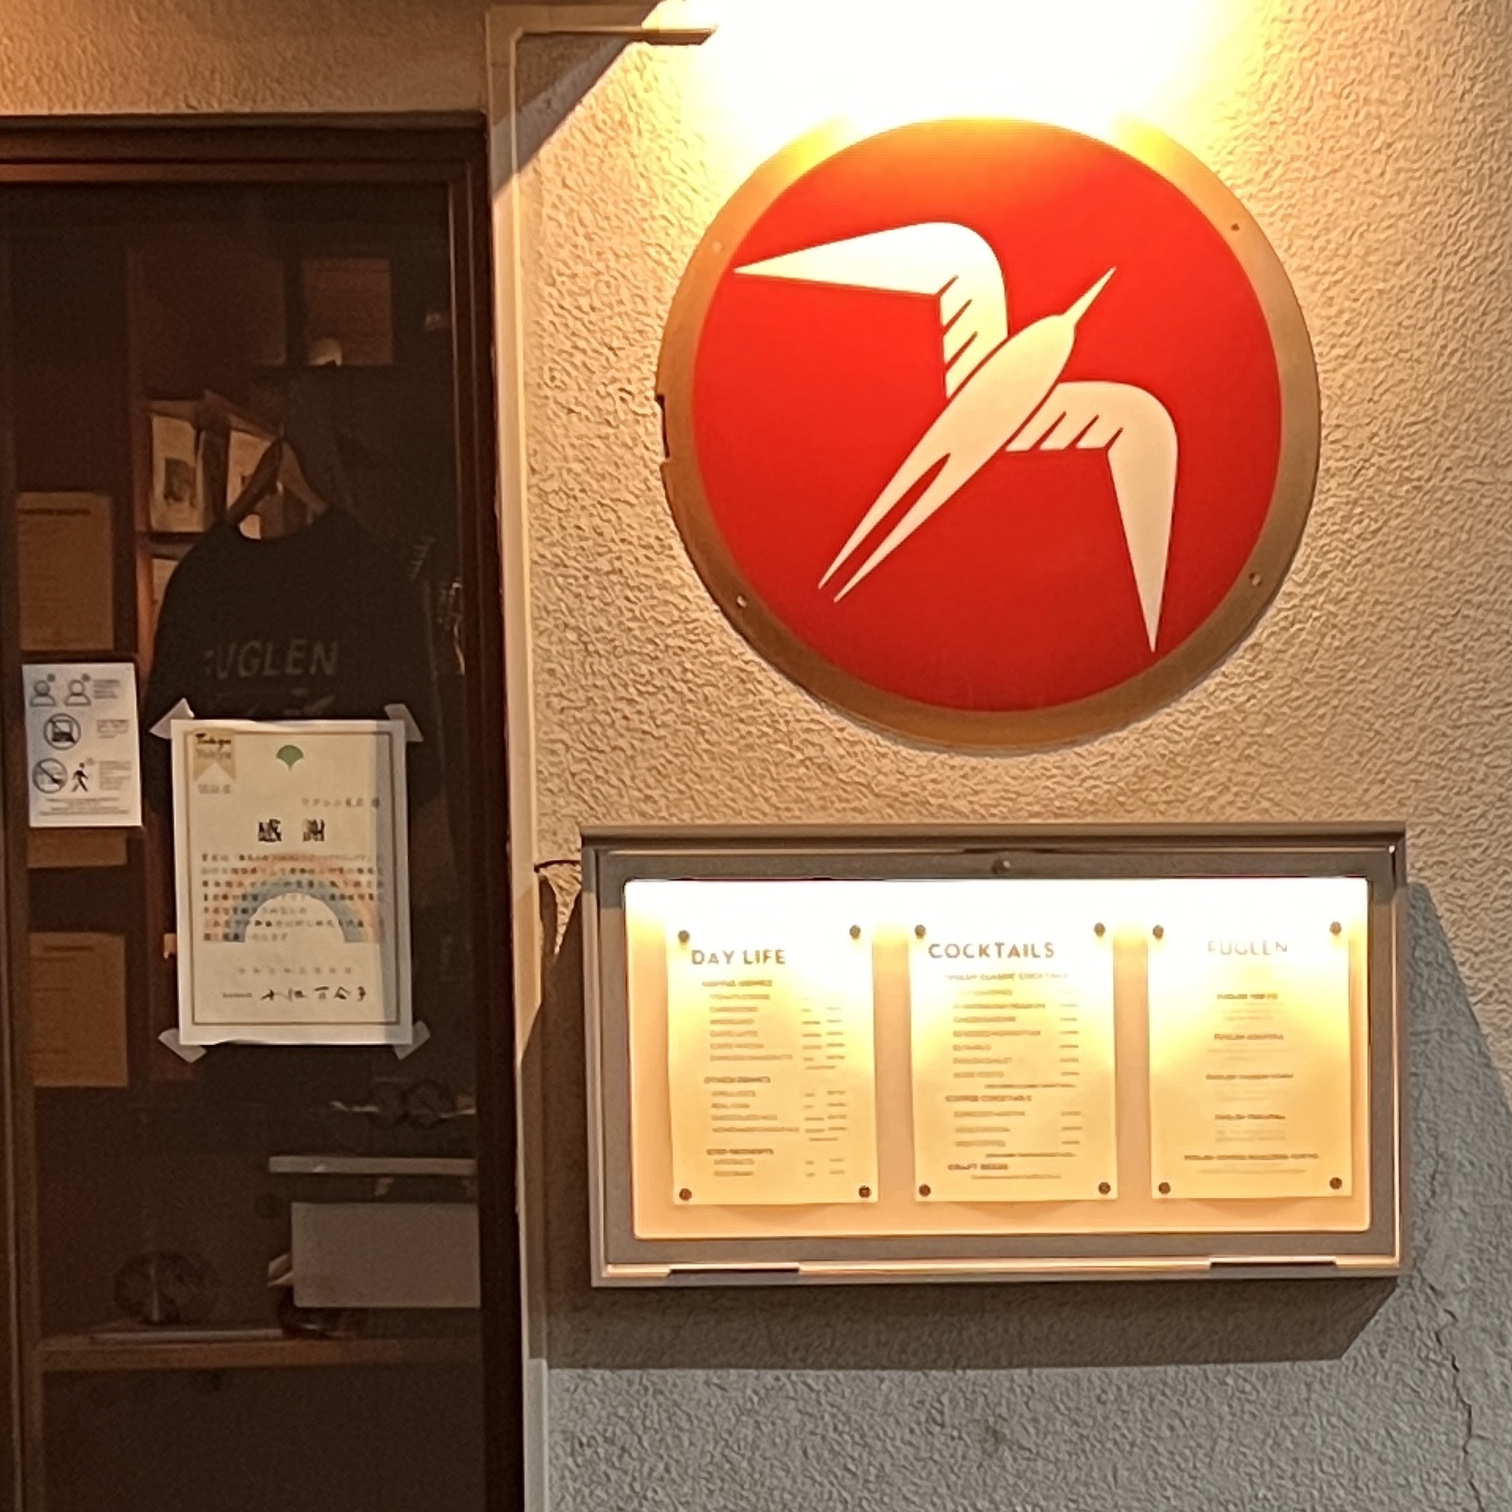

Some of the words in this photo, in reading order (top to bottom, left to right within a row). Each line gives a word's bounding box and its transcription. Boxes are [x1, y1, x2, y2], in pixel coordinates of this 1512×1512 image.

[691, 949, 735, 965] DAY
[742, 948, 786, 965] LIFE
[928, 942, 1055, 959] COCKTAILS
[1207, 940, 1288, 956] FUGLEN
